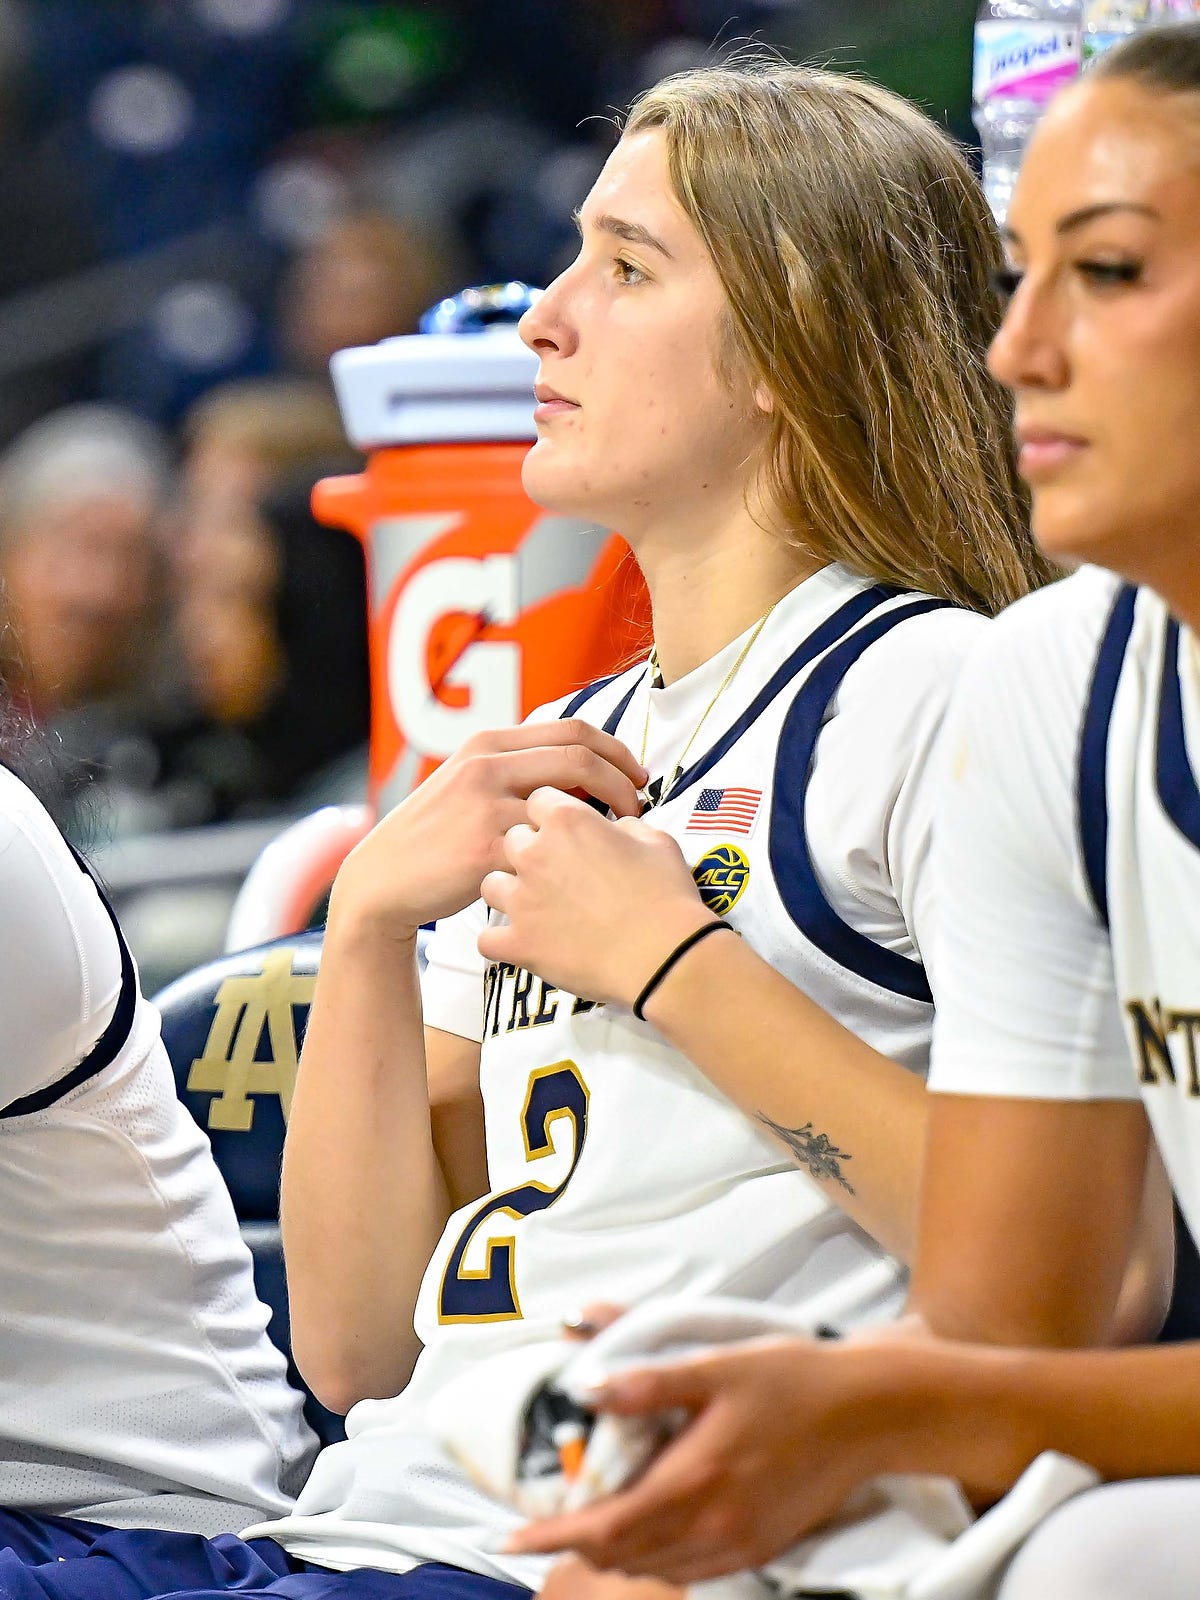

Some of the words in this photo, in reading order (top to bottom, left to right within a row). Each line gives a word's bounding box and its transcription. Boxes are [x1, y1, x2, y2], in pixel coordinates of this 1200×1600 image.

[387, 553, 521, 761] G
[697, 868, 748, 885] ACC
[438, 1058, 591, 1325] 2
